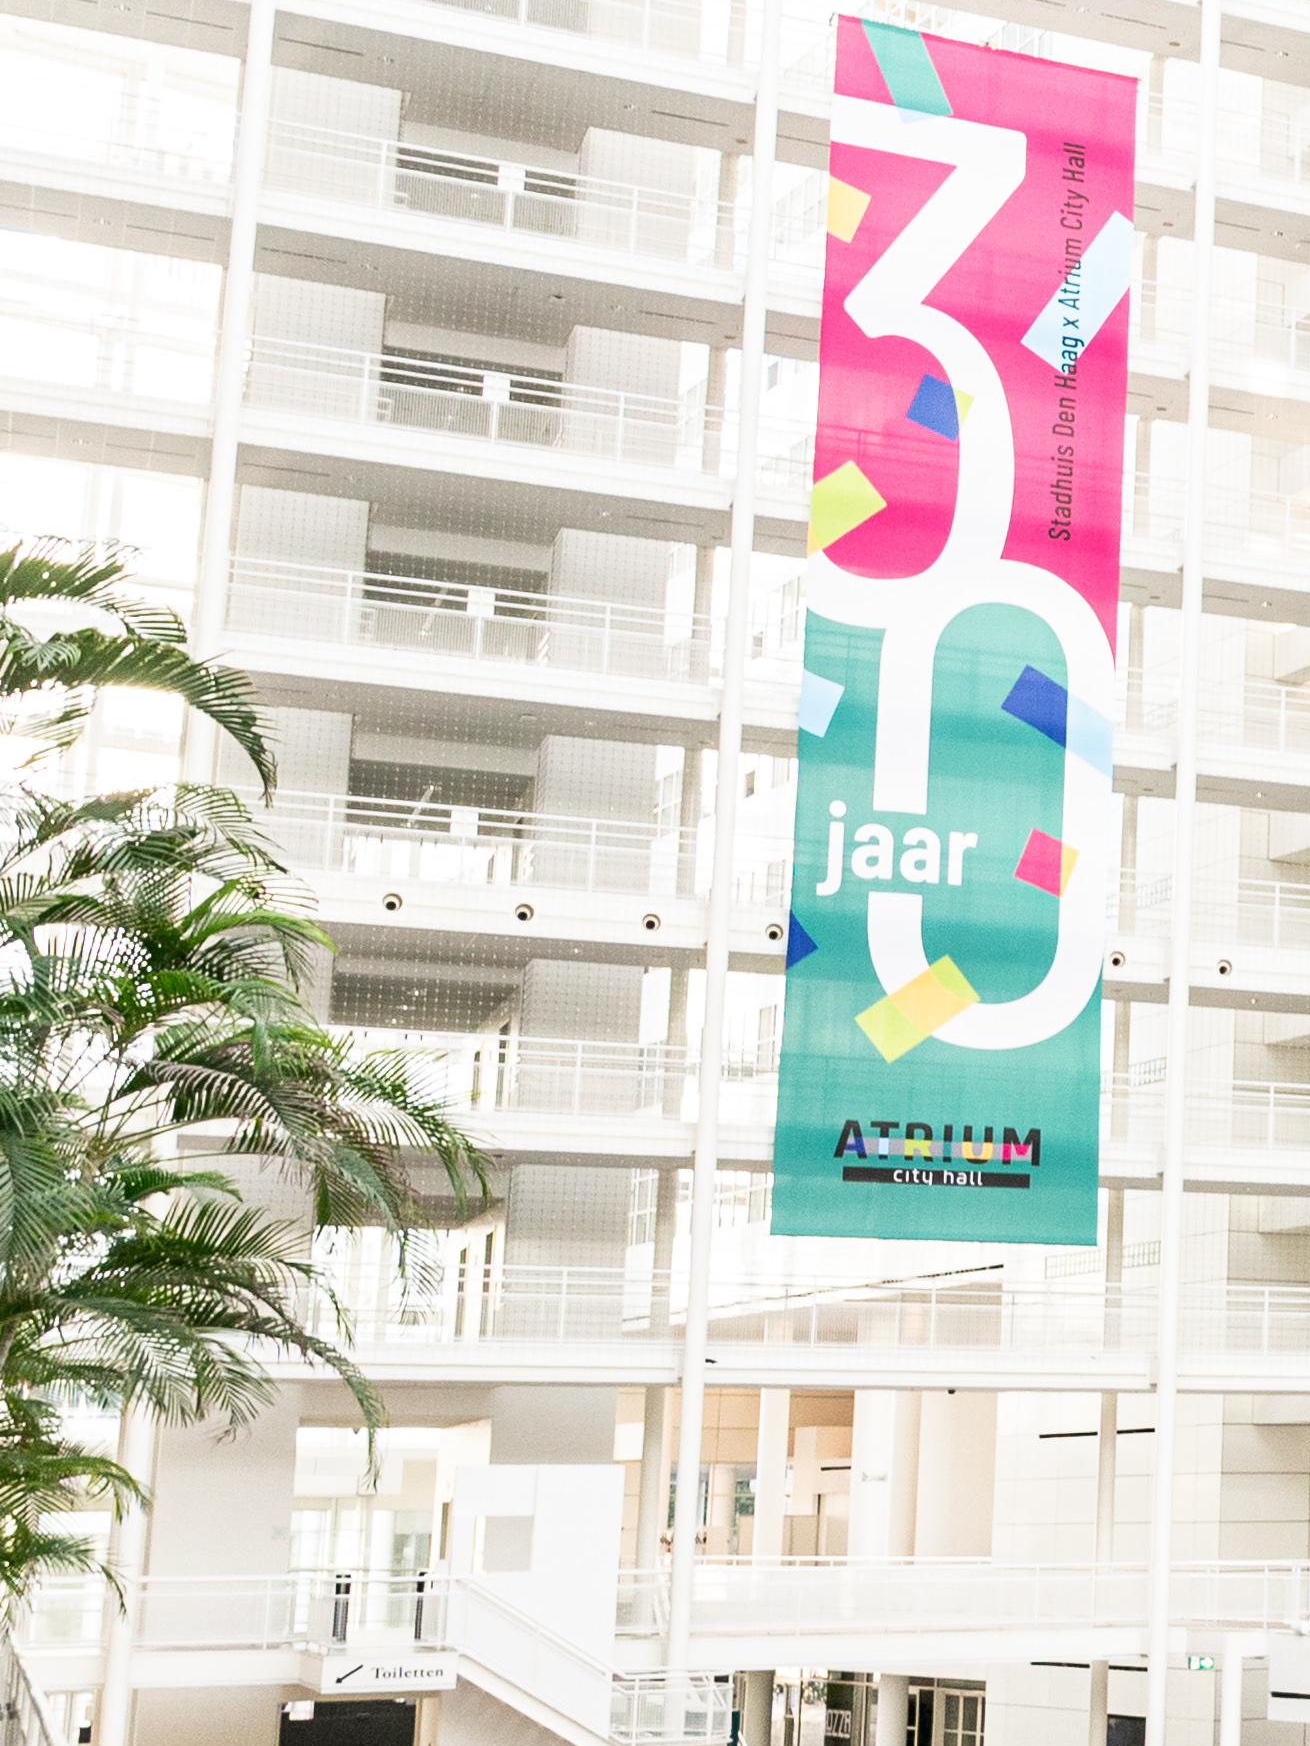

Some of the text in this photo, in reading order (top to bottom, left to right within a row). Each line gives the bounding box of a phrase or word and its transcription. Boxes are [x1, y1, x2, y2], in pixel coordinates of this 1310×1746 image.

[1048, 141, 1090, 542] Stadhuis Den Haag x Atrium City Hall
[815, 799, 979, 897] jaar
[833, 1118, 1042, 1168] ATRIUM
[893, 1167, 984, 1187] city hall
[371, 1666, 444, 1680] Toiletten
